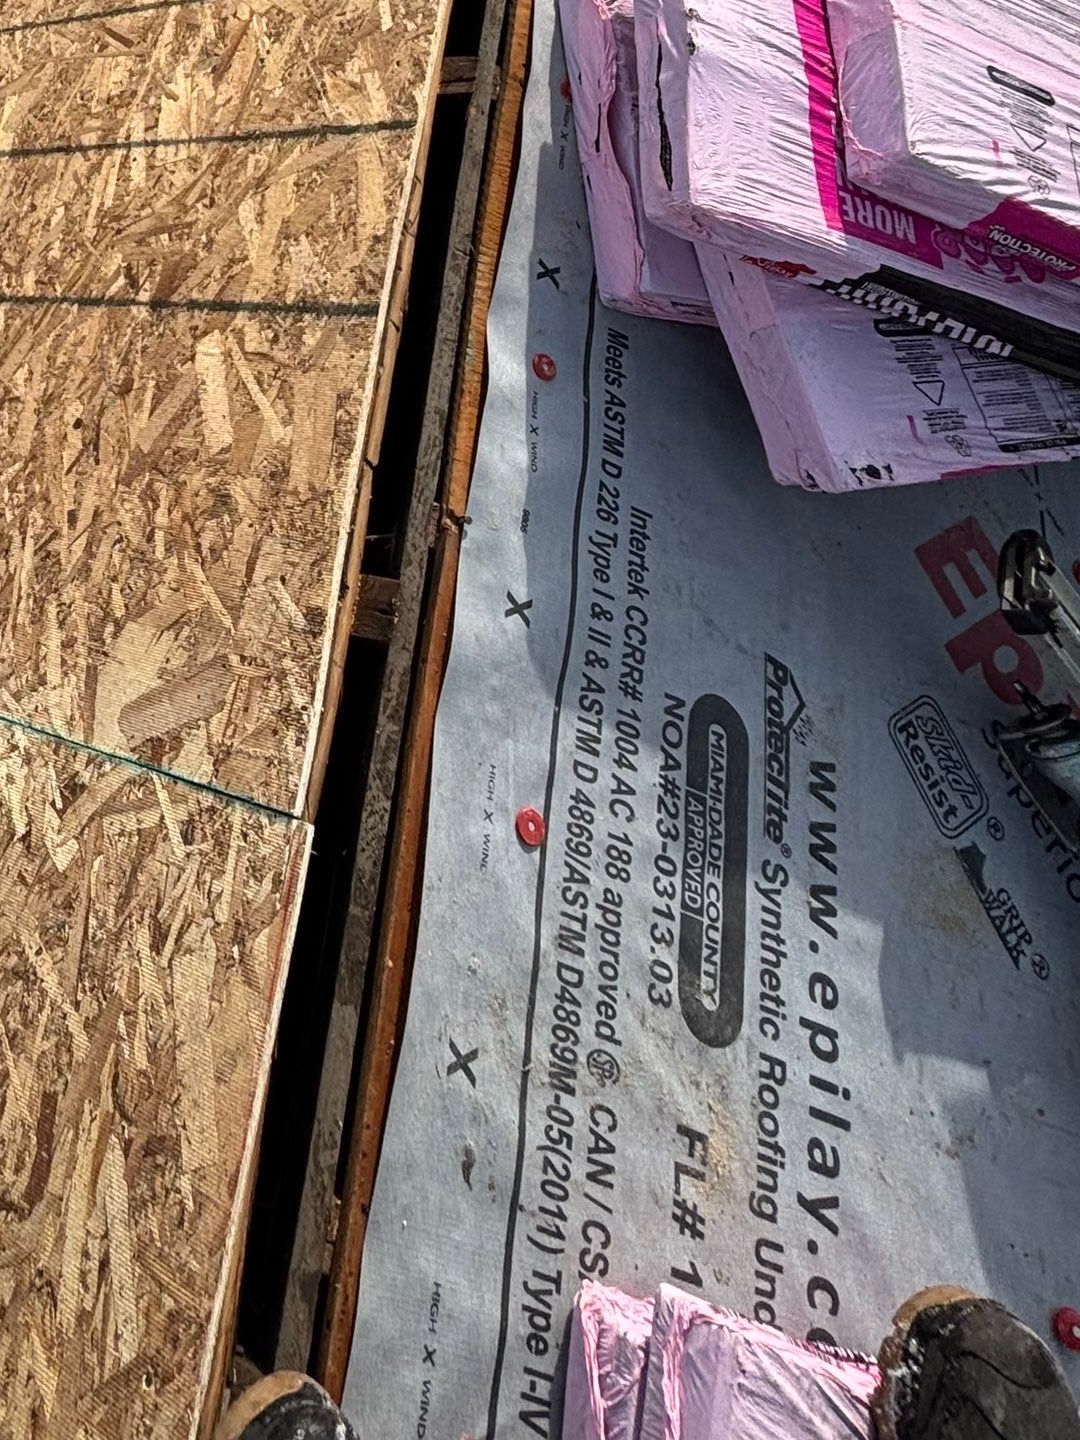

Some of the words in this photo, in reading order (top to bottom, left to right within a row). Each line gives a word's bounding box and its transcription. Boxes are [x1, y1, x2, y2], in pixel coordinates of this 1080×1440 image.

[837, 191, 917, 244] MORE
[987, 227, 1077, 272] PROTECTION
[604, 327, 629, 397] Meets
[600, 397, 626, 452] ASTM
[602, 455, 623, 479] D
[593, 481, 620, 525] 226
[588, 529, 618, 584] Type
[626, 505, 653, 600] Intertek
[590, 603, 614, 622] &
[593, 587, 615, 601] I
[584, 650, 609, 670] &
[587, 626, 611, 648] II
[617, 601, 649, 703] CCRR#
[573, 672, 604, 754] ASTM
[610, 708, 642, 774] 1004
[487, 763, 496, 801] HIGH
[573, 762, 598, 785] D
[895, 718, 962, 825] Resist
[914, 710, 983, 812] Skid-
[609, 771, 637, 824] AC
[705, 728, 725, 875] MIAMI-DADE
[557, 795, 596, 958] 4869/ASTM
[604, 832, 634, 884] 188
[647, 692, 687, 1010] NOA#23-0313.03
[683, 797, 706, 910] APPROVED
[700, 879, 722, 1008] COUNTY
[754, 860, 789, 1042] Synthetic
[979, 888, 1028, 964] WALK
[994, 886, 1035, 949] GRIP
[593, 886, 624, 1047] approved
[526, 961, 584, 1255] D4869M-05(2011)
[749, 1052, 787, 1224] Roofing
[585, 1104, 618, 1190] CAN
[583, 1191, 613, 1215] /
[671, 1123, 709, 1242] FL#
[429, 1280, 441, 1335] HIGH
[670, 1259, 703, 1289] 1
[522, 1269, 562, 1357] Type
[416, 1378, 432, 1439] WIND
[519, 1366, 555, 1440] I-IV
